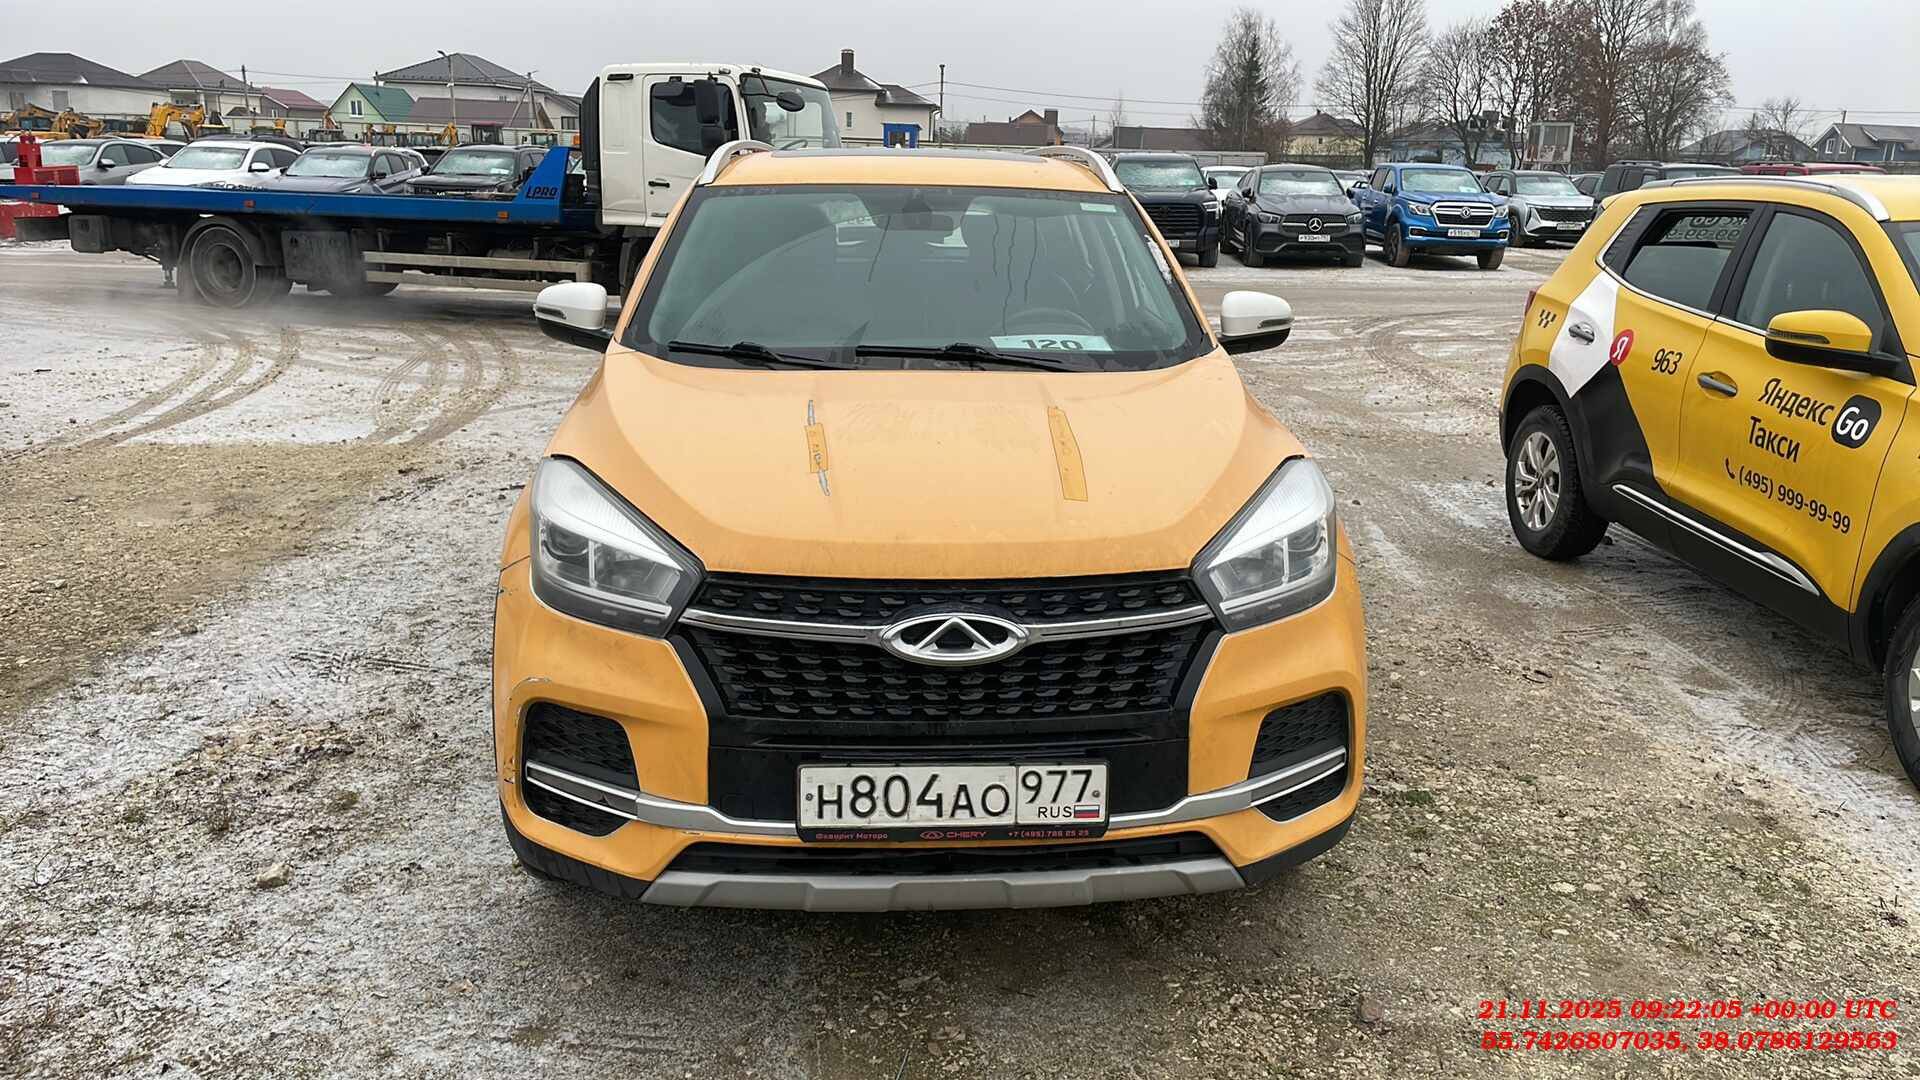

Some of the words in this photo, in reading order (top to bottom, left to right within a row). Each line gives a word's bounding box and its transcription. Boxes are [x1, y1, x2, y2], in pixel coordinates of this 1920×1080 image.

[526, 186, 558, 199] LPRO
[1612, 335, 1630, 360] Я
[1651, 348, 1683, 375] 963
[1758, 377, 1835, 426] Яндекс
[1835, 406, 1870, 441] Go
[1748, 415, 1801, 463] Такси
[1739, 465, 1774, 499] (495)
[1777, 484, 1851, 534] 999-99-99
[816, 774, 1010, 819] Н804АО
[1020, 769, 1093, 804] 977
[1037, 806, 1073, 818] RUS
